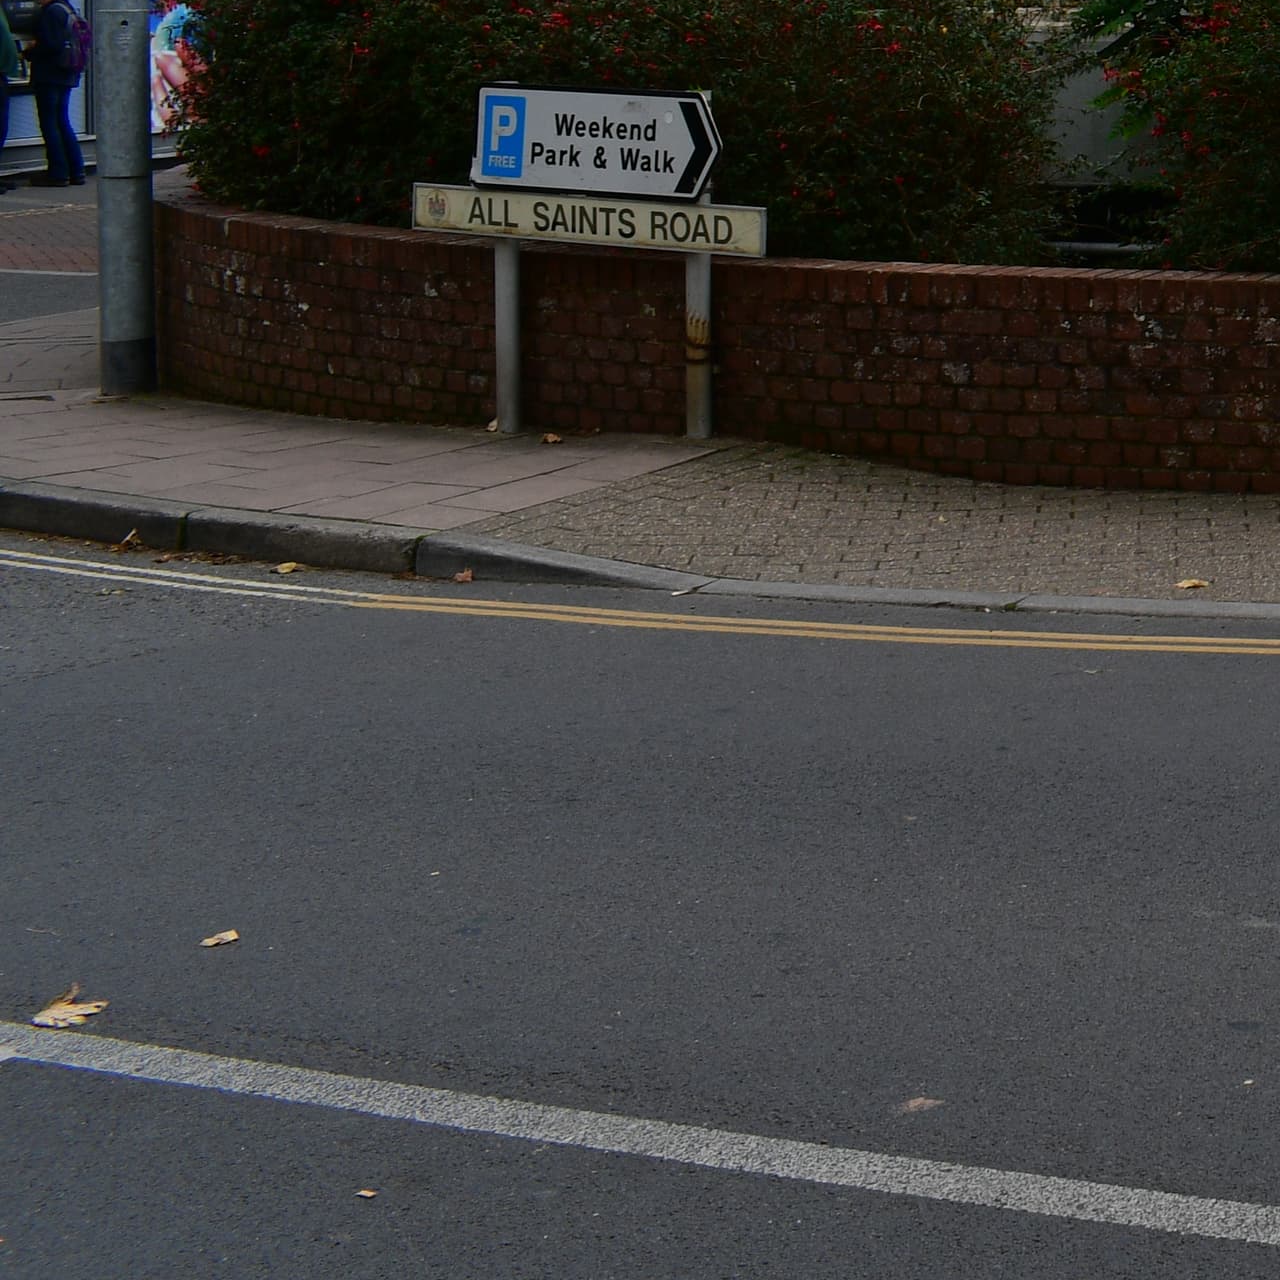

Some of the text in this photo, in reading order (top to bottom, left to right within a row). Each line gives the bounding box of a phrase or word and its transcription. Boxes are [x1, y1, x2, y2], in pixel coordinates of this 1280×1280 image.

[491, 105, 517, 152] P
[554, 113, 657, 142] Weekend
[488, 154, 516, 169] FREE
[530, 142, 676, 174] Park & Walk
[468, 197, 734, 245] ALL SAINTS ROAD
